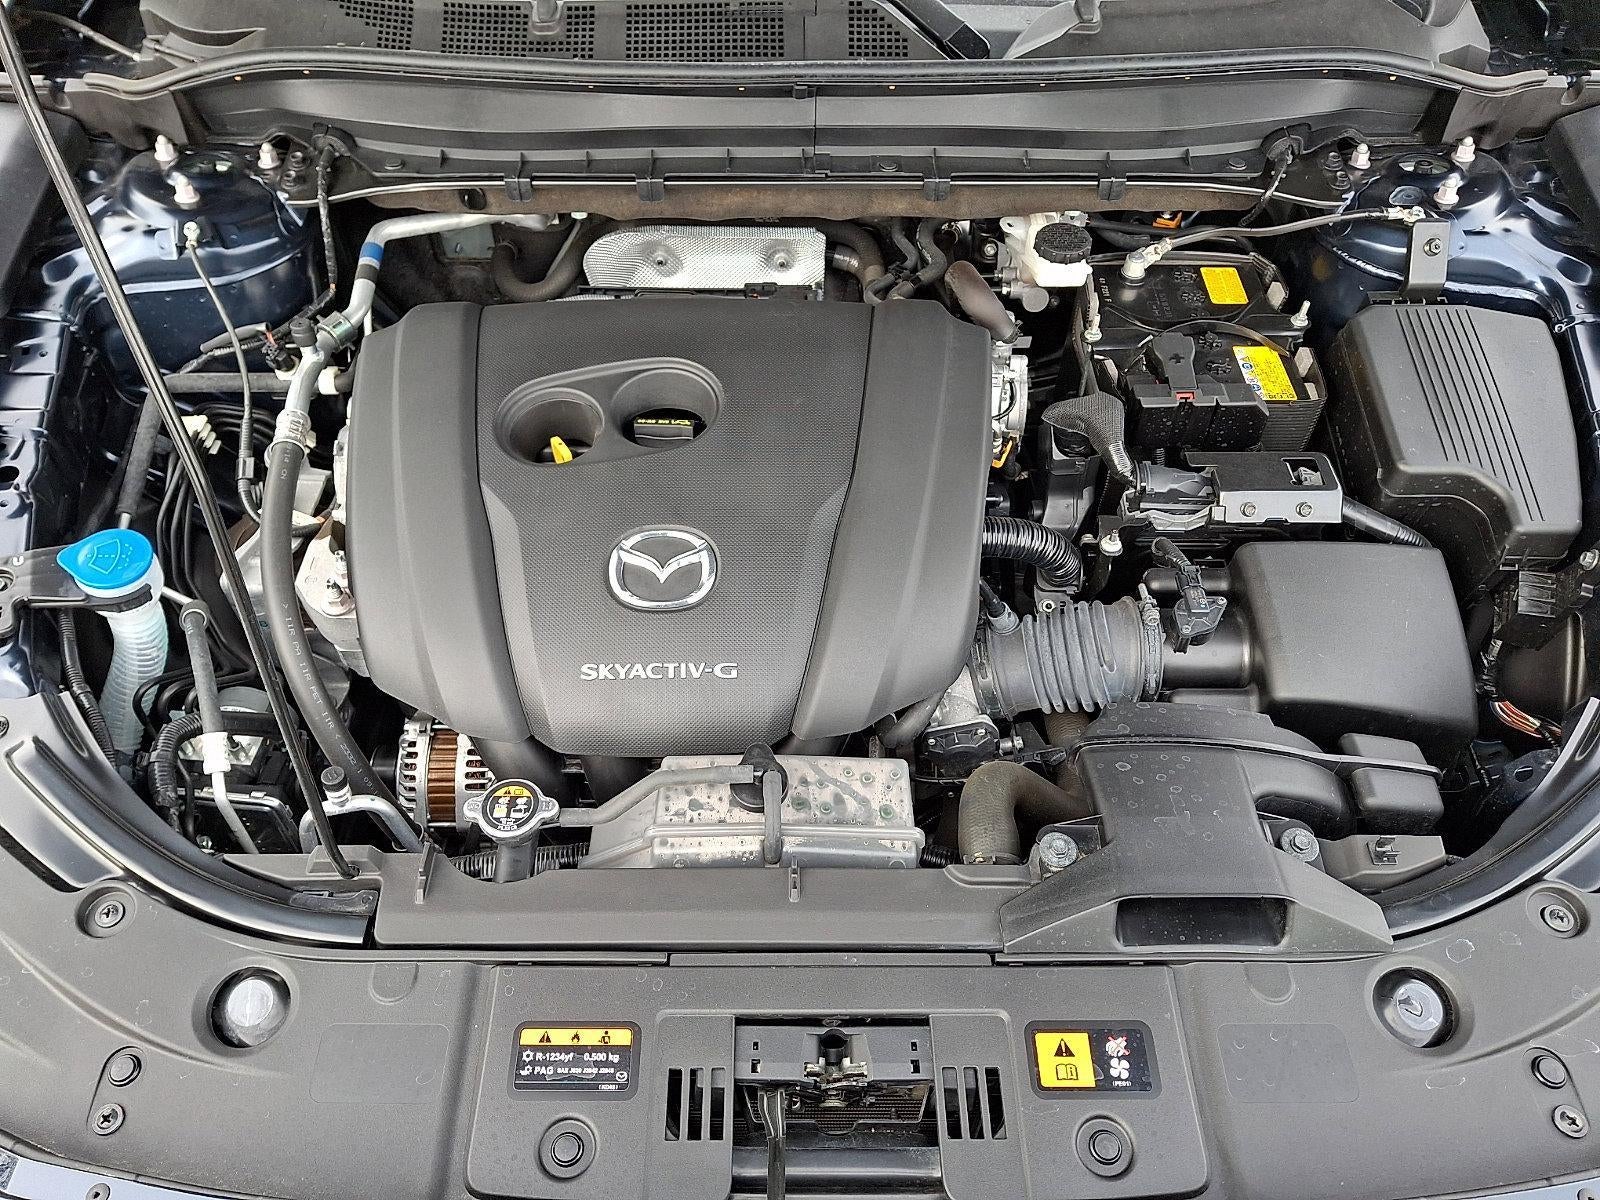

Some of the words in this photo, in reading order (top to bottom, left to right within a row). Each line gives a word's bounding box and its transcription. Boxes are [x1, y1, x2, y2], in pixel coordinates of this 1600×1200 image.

[580, 662, 738, 681] SKYACTIV-G
[535, 1052, 574, 1062] R-1234yf
[583, 1052, 607, 1061] 0.500
[608, 1052, 620, 1063] kg
[534, 1066, 554, 1075] PAG
